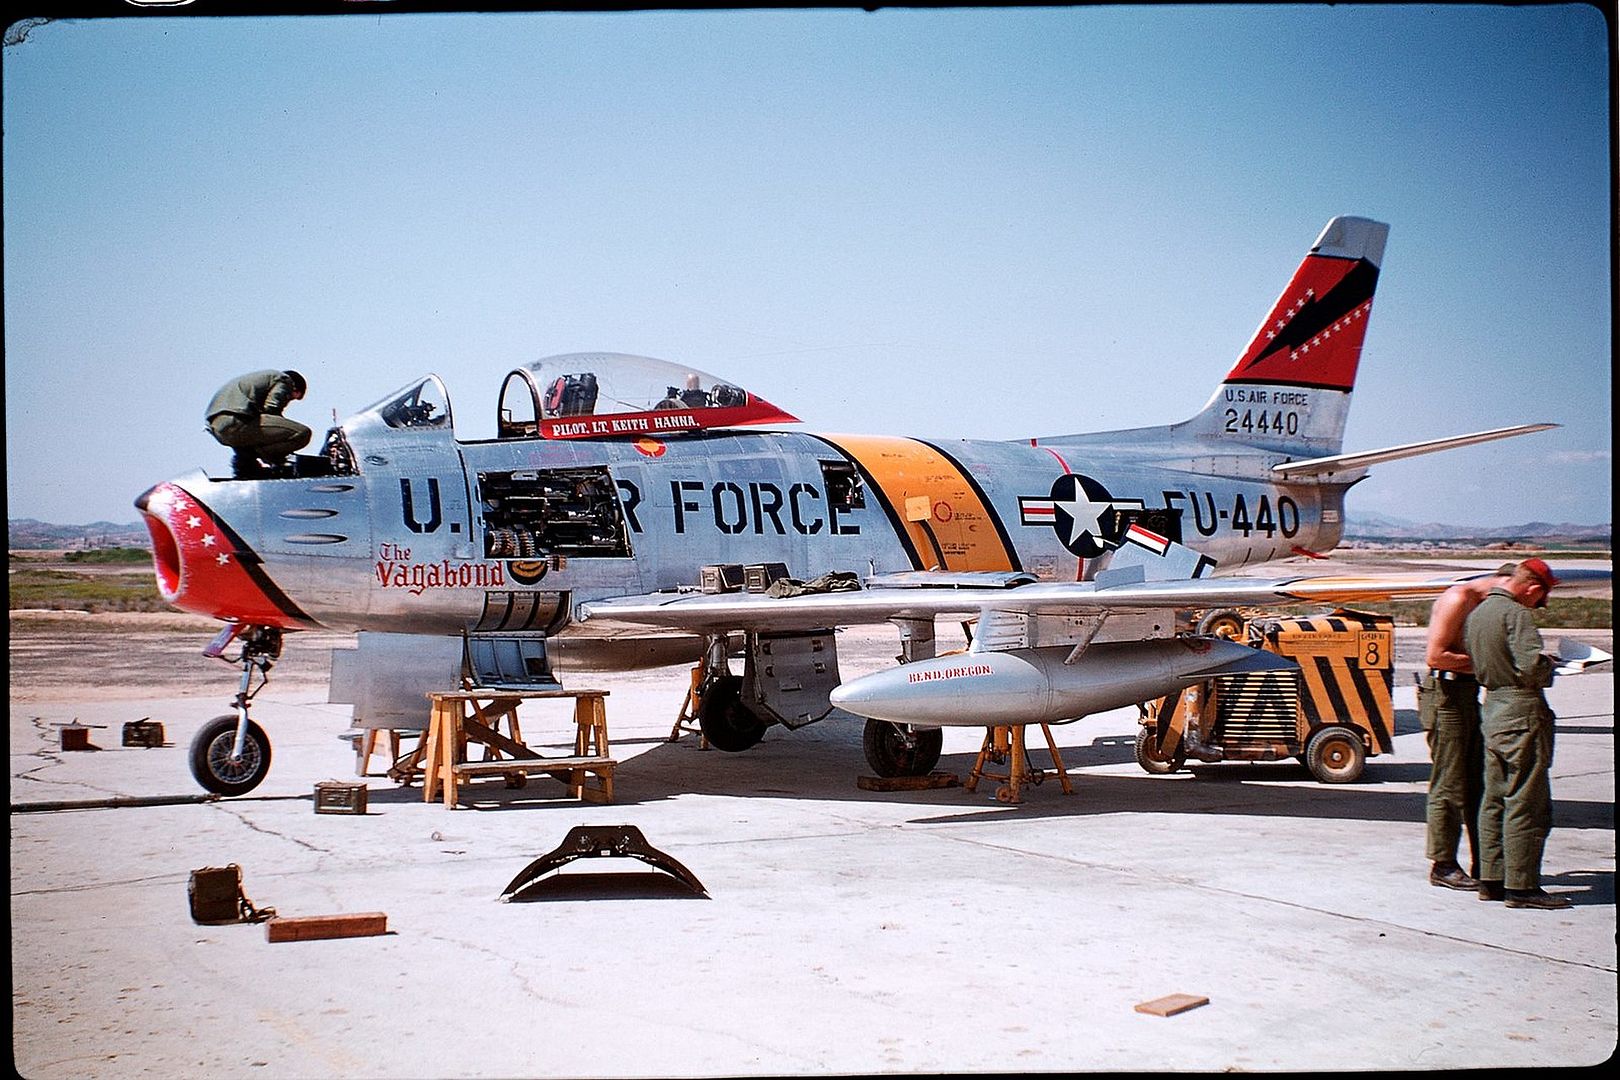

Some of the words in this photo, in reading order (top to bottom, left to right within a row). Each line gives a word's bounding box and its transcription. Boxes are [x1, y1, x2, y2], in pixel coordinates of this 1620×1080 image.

[1273, 391, 1308, 406] FORCE
[552, 424, 590, 436] PILOT.
[611, 418, 649, 431] KEITH
[654, 415, 700, 429] HANNA.
[1225, 408, 1298, 435] 24440
[379, 542, 411, 561] The
[375, 559, 505, 596] Vagabond
[1365, 642, 1379, 665] 8
